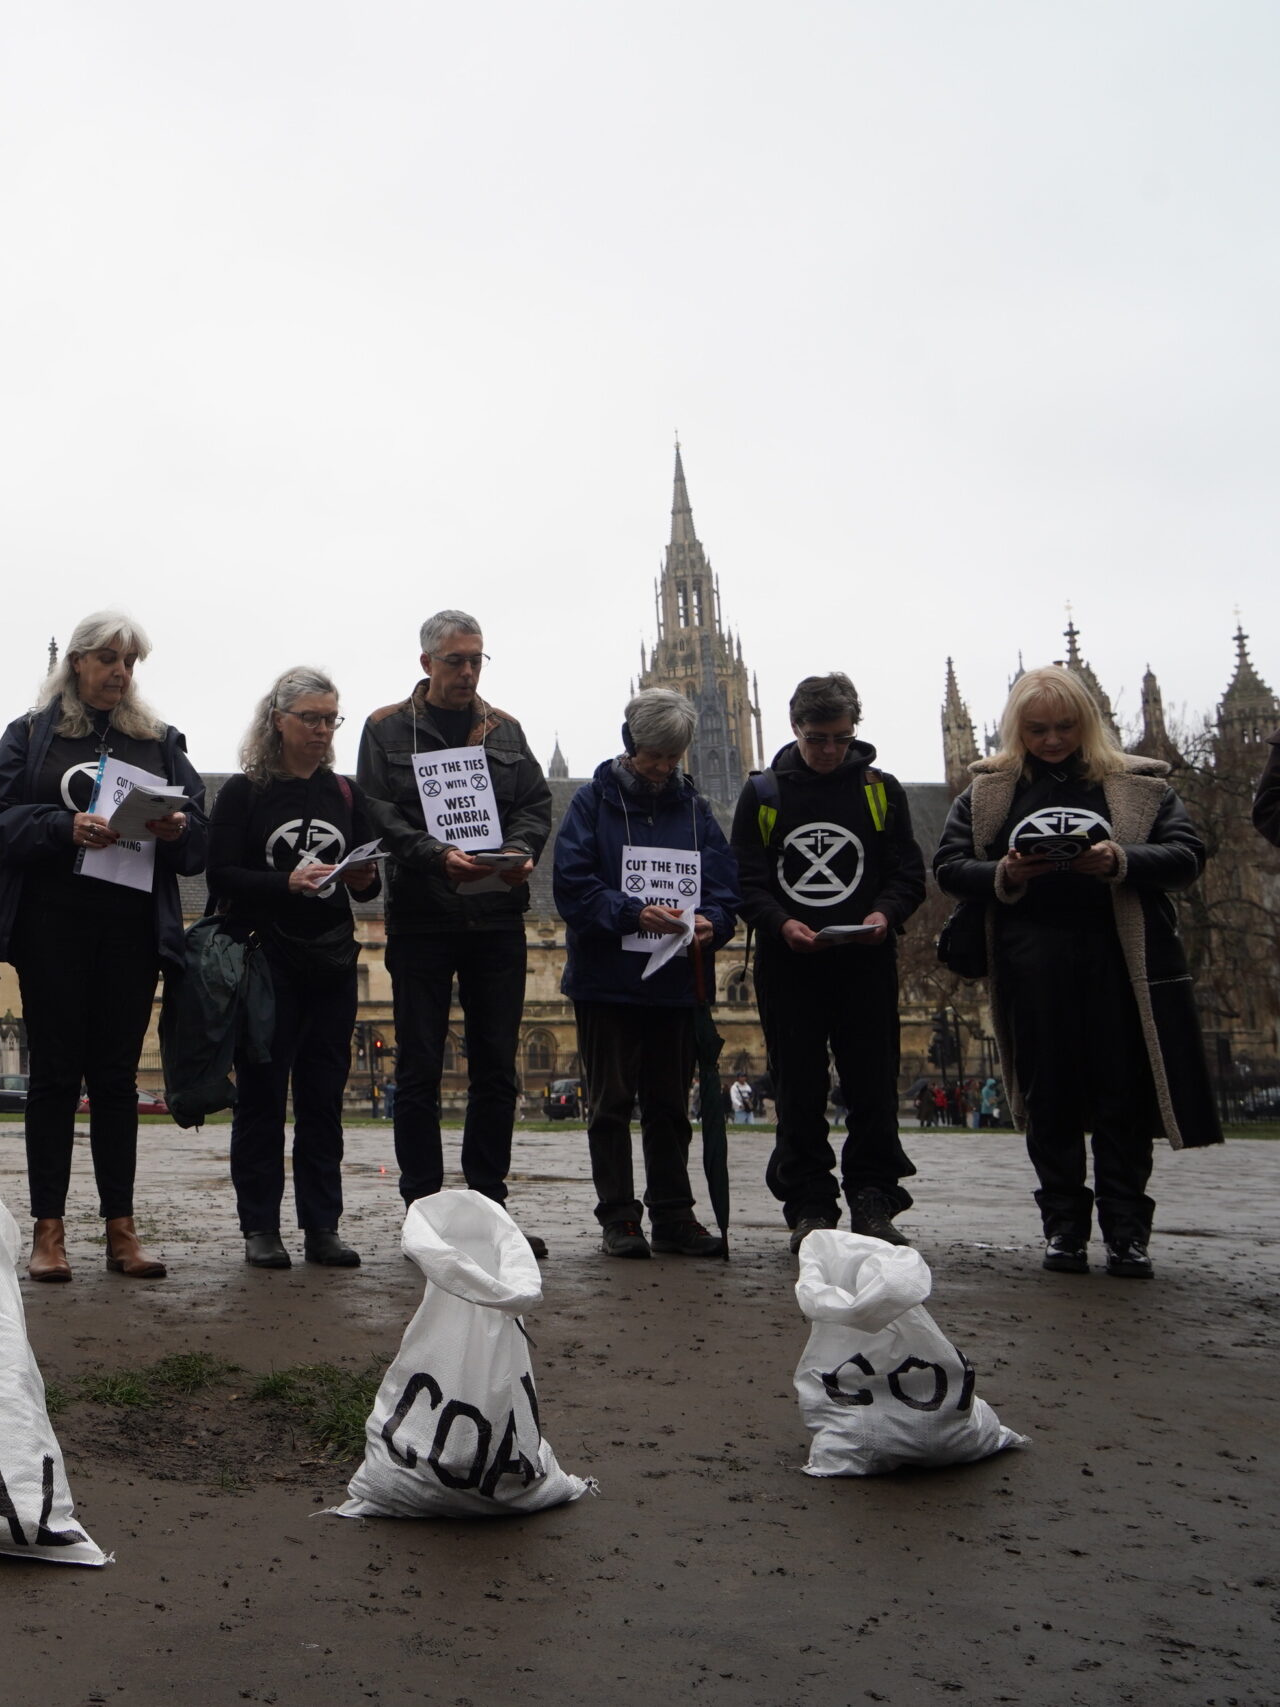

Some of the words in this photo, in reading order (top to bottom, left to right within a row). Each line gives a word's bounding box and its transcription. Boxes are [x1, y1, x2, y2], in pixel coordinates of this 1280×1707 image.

[419, 765, 438, 777] CUT
[441, 761, 462, 773] THE
[463, 759, 484, 771] TIES
[117, 776, 128, 789] CUT
[445, 779, 467, 789] WITH
[444, 796, 476, 810] WEST
[436, 809, 491, 827] CUMBRIA
[445, 824, 489, 841] MINING
[115, 840, 141, 852] INING
[626, 860, 647, 871] CUT
[650, 861, 671, 873] THE
[675, 863, 697, 875] TIES
[650, 879, 674, 890] WITH
[645, 897, 679, 909] WEST
